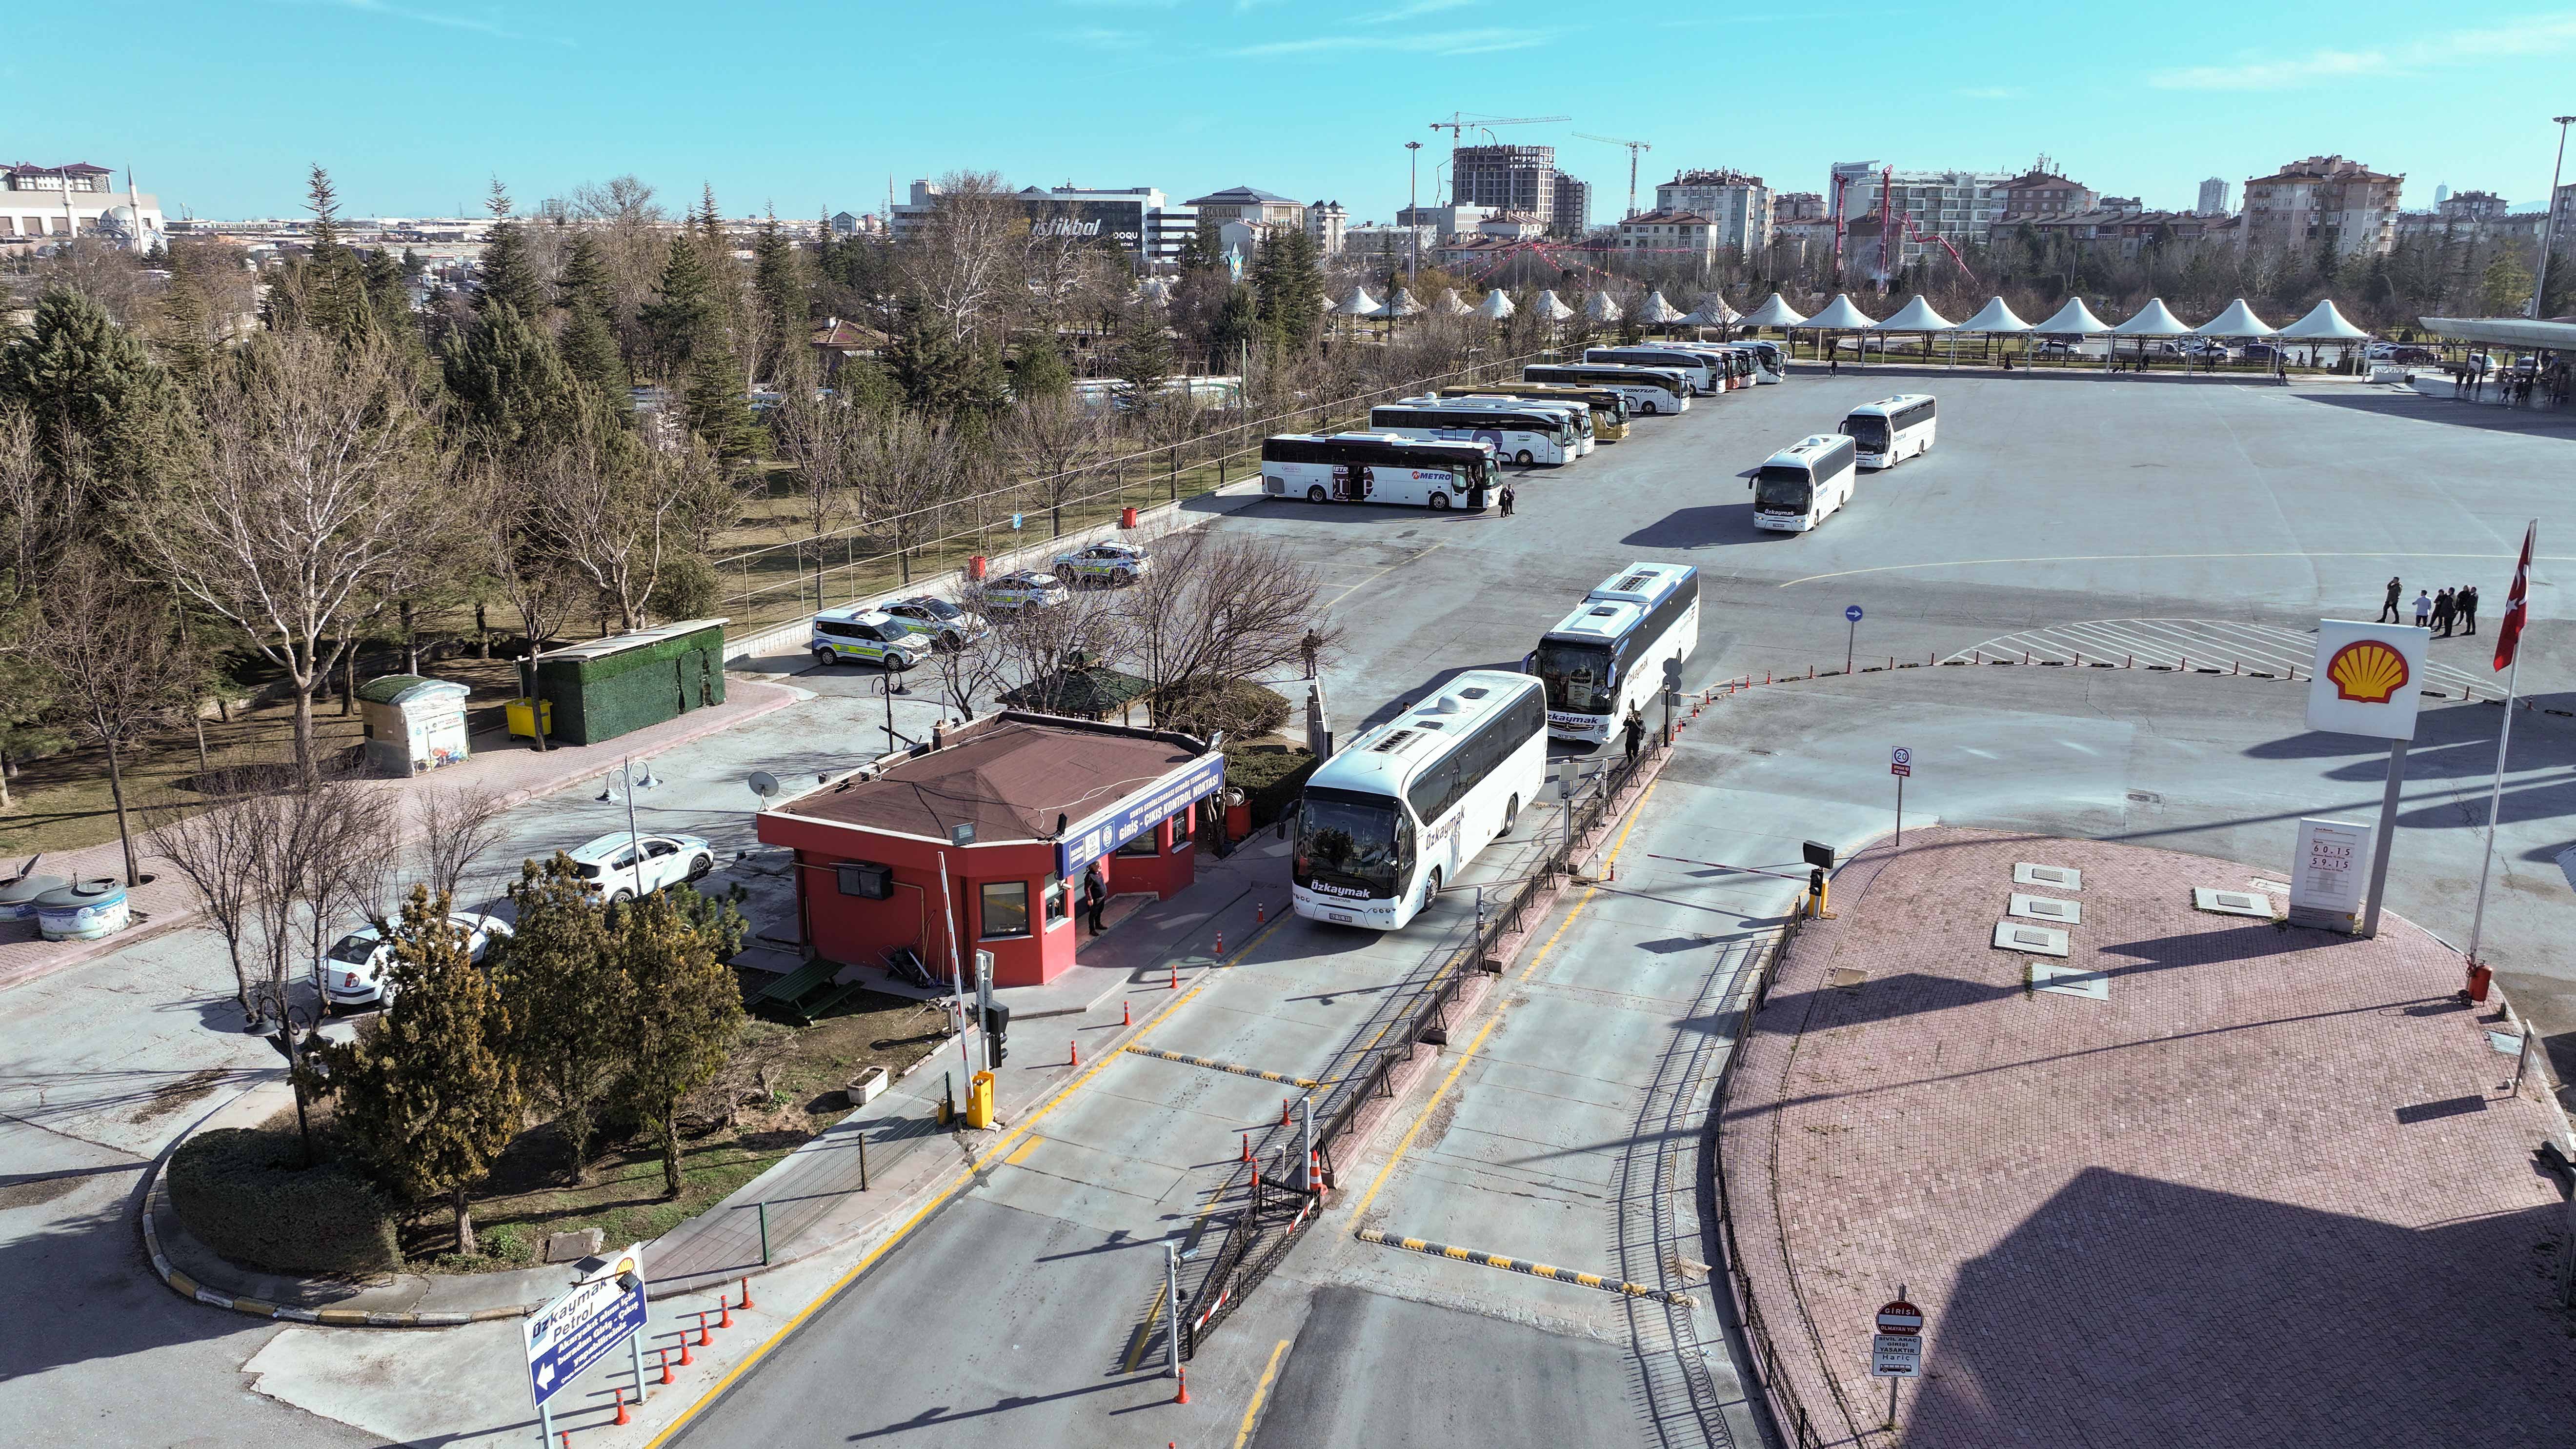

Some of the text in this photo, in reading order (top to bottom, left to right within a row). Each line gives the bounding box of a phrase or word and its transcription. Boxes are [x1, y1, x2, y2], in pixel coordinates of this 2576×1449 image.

[1031, 218, 1101, 236] istikbal
[1113, 232, 1138, 240] DOQU
[1547, 713, 1599, 724] zkaymak
[1119, 820, 1139, 841] GİRİŞ
[1144, 806, 1163, 827] ÇIKIŞ
[1164, 789, 1192, 815] KONTROL
[1193, 773, 1218, 798] NOKTASI
[1426, 805, 1465, 851] Özkaymak
[2314, 845, 2350, 856] 60.15
[2312, 858, 2349, 868] 59.15
[1311, 879, 1370, 898] Özkaymak
[621, 1291, 636, 1307] için
[533, 1279, 607, 1339] Özkaymak
[554, 1302, 593, 1343] Petrol
[558, 1336, 592, 1366] buradan
[593, 1320, 613, 1338] Giriş
[618, 1301, 639, 1321] Çıkış
[573, 1321, 627, 1368] yapabilirsiniz
